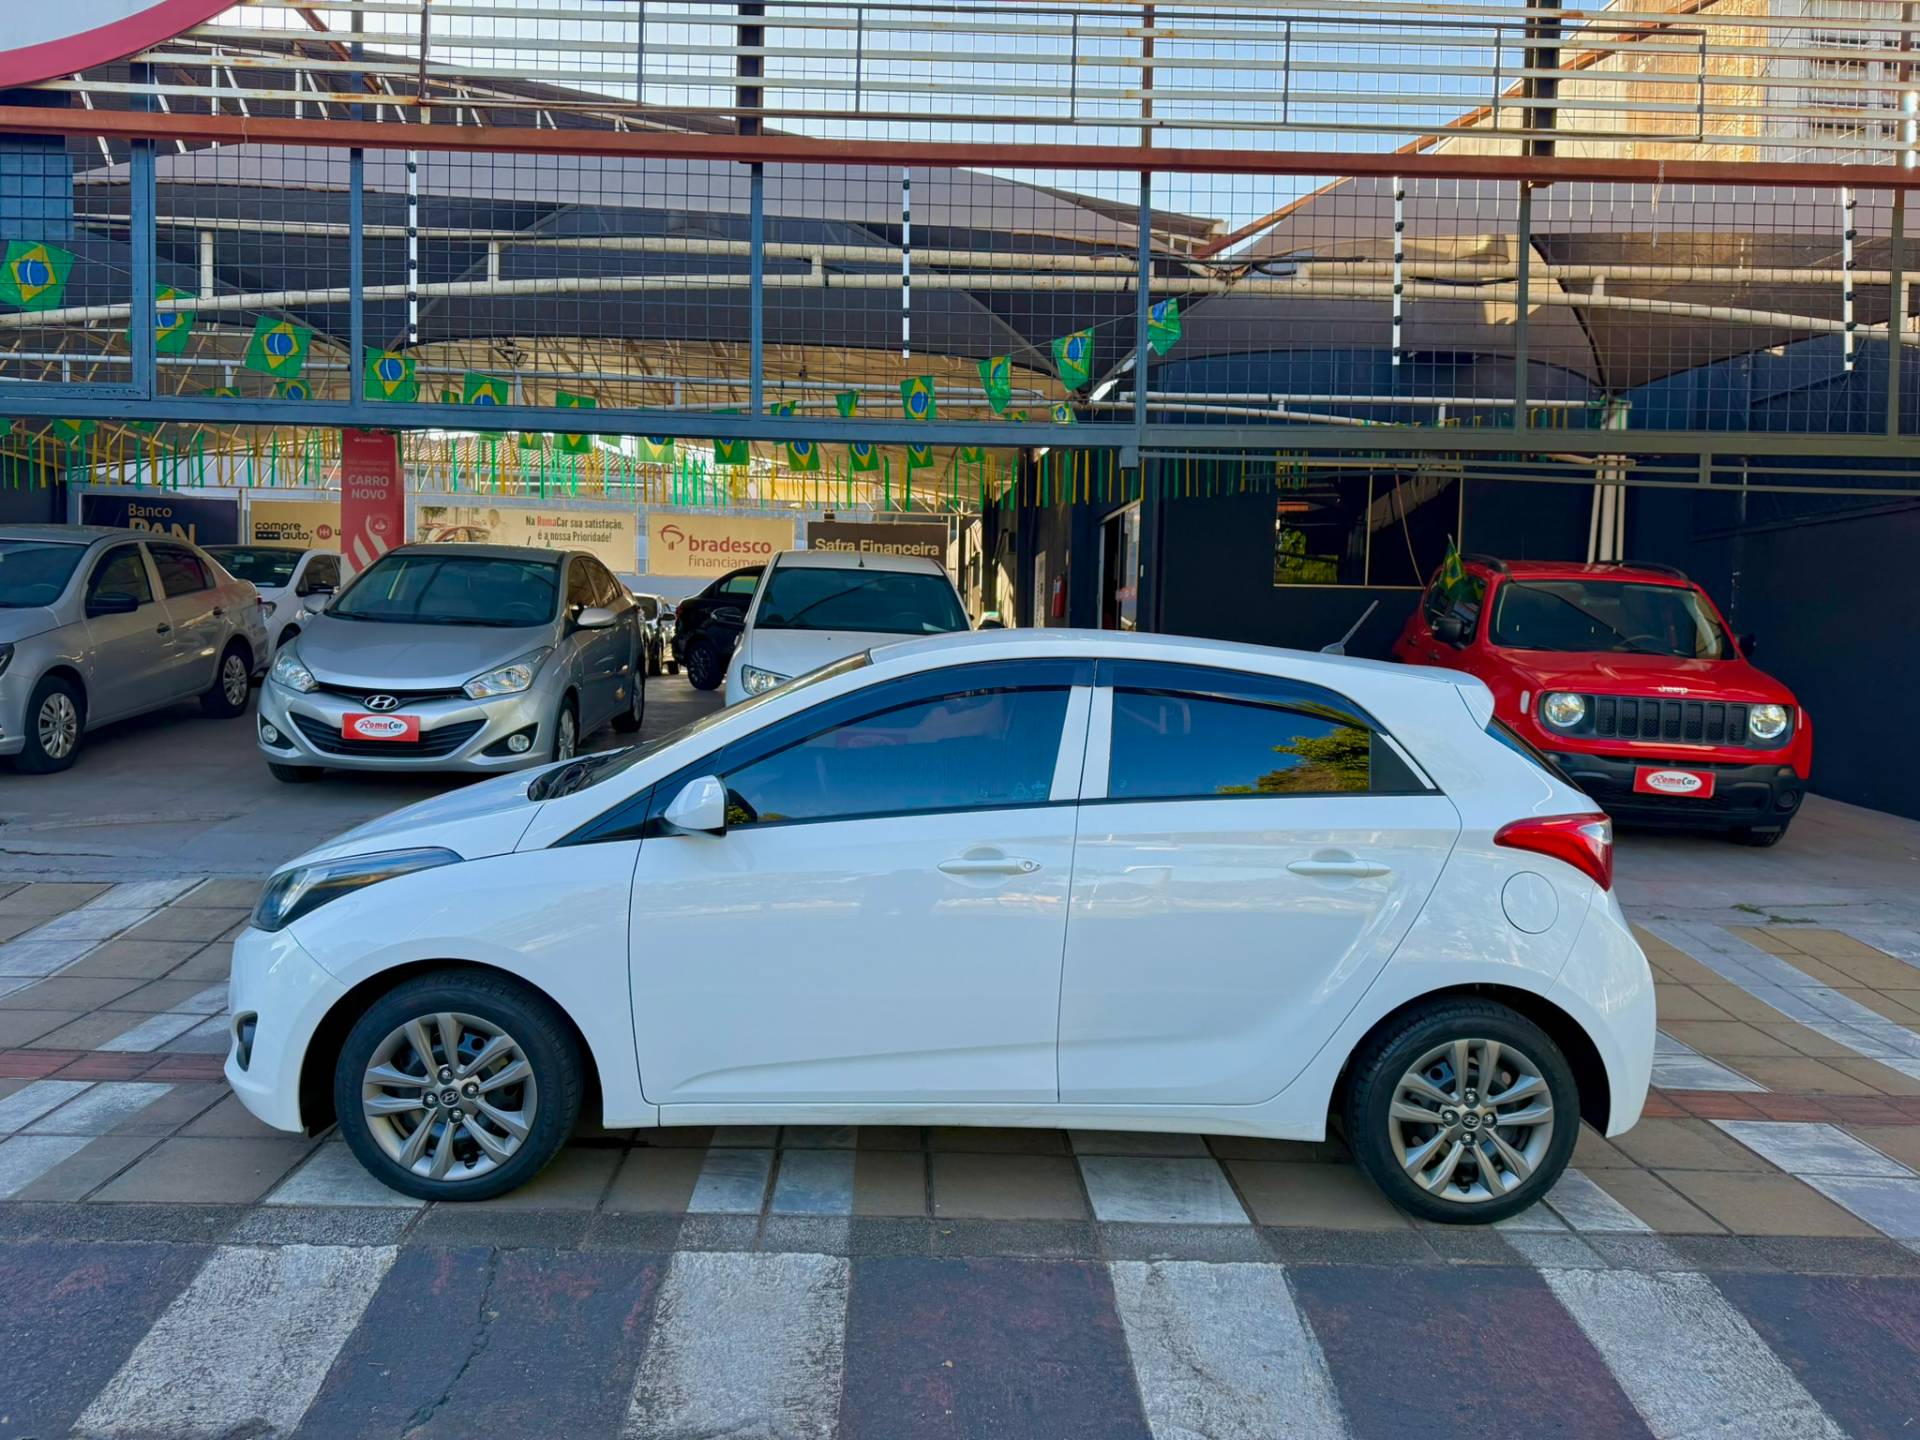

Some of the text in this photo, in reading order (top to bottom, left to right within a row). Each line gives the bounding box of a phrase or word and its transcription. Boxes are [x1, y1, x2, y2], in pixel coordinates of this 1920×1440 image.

[348, 474, 390, 486] CARRO
[351, 488, 386, 500] NOVO
[128, 503, 172, 518] Banco
[254, 522, 302, 532] compre
[526, 515, 535, 526] Na
[570, 519, 583, 528] sua
[282, 531, 310, 541] auto
[550, 532, 571, 542] nossa
[572, 531, 612, 543] Prioridade!
[688, 535, 772, 554] bradesco
[815, 538, 939, 556] Safra Financeira
[360, 719, 403, 730] RomaCar
[1652, 774, 1697, 786] RomaCar
